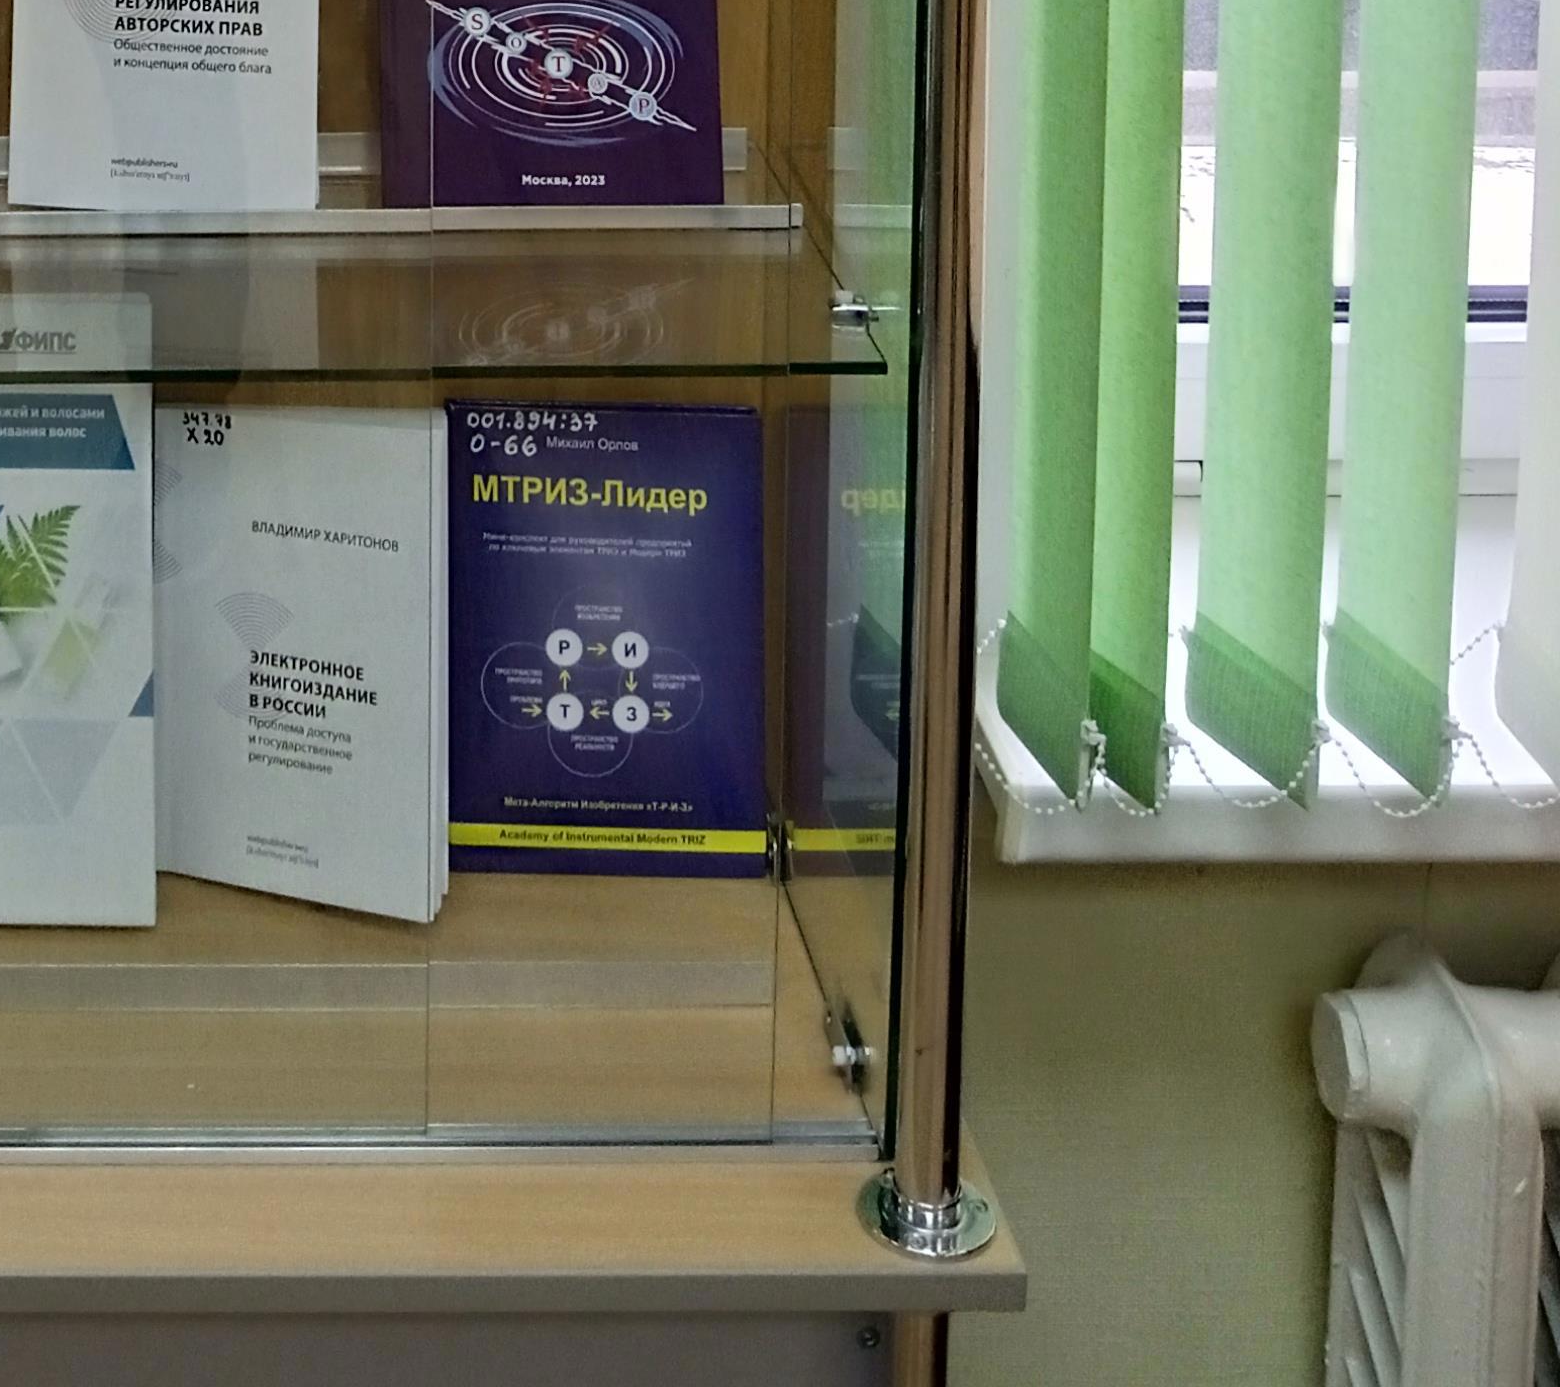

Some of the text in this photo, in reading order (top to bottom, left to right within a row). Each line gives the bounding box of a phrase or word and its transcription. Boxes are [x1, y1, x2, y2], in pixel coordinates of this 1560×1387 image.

[115, 17, 263, 37] АВТОРСКИХ ПРАВ
[114, 39, 269, 57] Общественное достояние
[114, 58, 272, 74] и концепция общего блага
[522, 175, 605, 187] Москва, 2023
[18, 332, 76, 352] ФИПС
[30, 408, 39, 418] и
[42, 407, 104, 419] волосами
[49, 425, 87, 438] волос
[204, 428, 224, 446] 20
[546, 435, 638, 452] Михаил Орлов
[473, 475, 707, 516] МТРИЗ-Лидер
[252, 521, 400, 552] ВЛАДИМИР ХАРИТОНОВ
[559, 641, 637, 657] Р И
[250, 650, 364, 681] ЭЛЕКТРОННОЕ
[249, 673, 377, 706] КНИГОИЗДАНИЕ
[249, 693, 327, 719] В РОССИИ
[559, 705, 571, 718] Т
[248, 715, 351, 744] Проблема доступа
[248, 736, 256, 746] и
[499, 829, 706, 844] Academy of Instrumental Modern TRIZ
